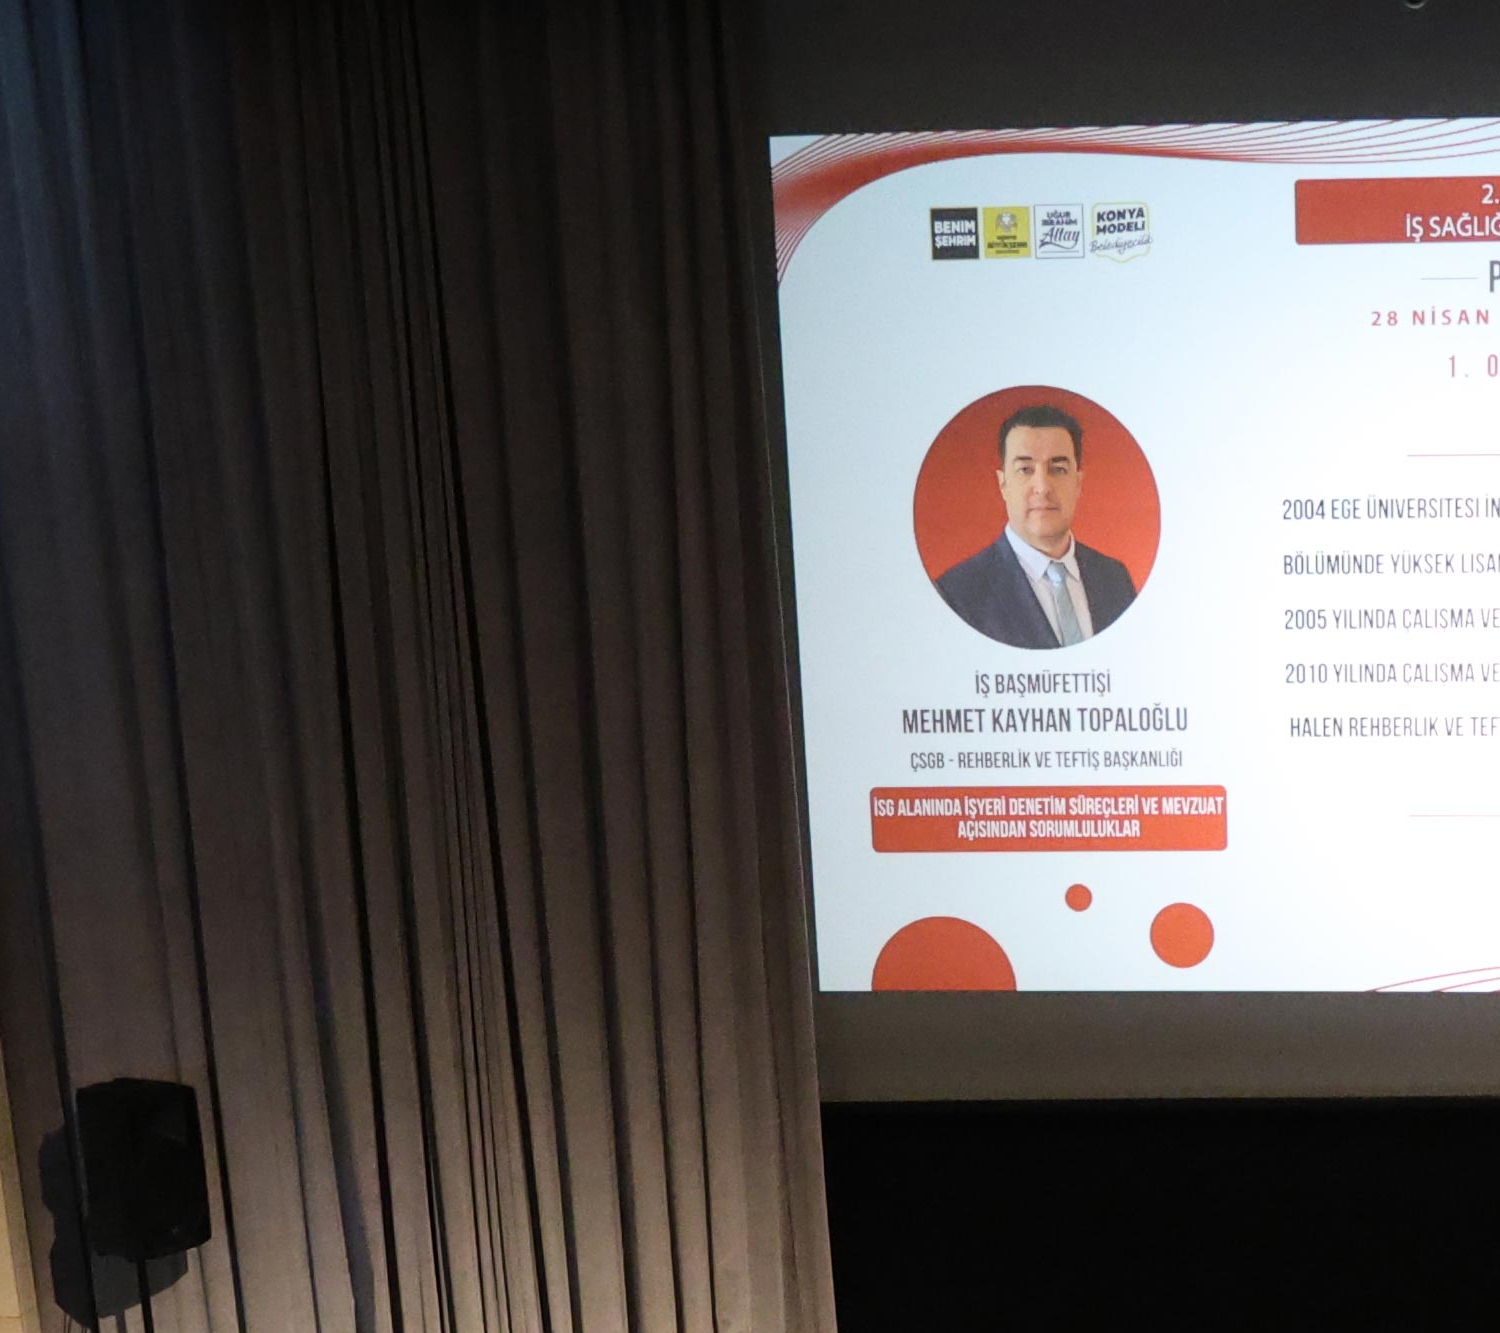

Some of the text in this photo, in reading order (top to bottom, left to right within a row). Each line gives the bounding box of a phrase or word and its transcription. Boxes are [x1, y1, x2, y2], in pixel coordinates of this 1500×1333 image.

[1481, 183, 1500, 205] 2.
[1096, 207, 1144, 222] KONYA
[1406, 214, 1424, 243] İŞ
[1372, 311, 1398, 326] 28
[1412, 306, 1489, 326] NİSAN
[1449, 355, 1468, 378] 1.
[1283, 499, 1325, 520] 2004
[1331, 498, 1361, 520] EGE
[1284, 550, 1383, 575] BÖLÜMÜNDE
[1391, 550, 1454, 574] YÜKSEK
[1285, 609, 1327, 630] 2005
[1333, 609, 1396, 629] YILINDA
[1403, 608, 1474, 632] ÇALIŞMA
[1481, 608, 1500, 628] VE
[975, 669, 1110, 698] İŞ BAŞMÜFETTİŞİ
[1286, 663, 1327, 684] 2010
[1333, 663, 1397, 683] YILINDA
[1403, 663, 1474, 685] ÇALIŞMA
[1481, 663, 1499, 682] VE
[902, 703, 1187, 734] MEHMET KAYHAN TOPALOĞLU
[1291, 717, 1342, 737] HALEN
[1445, 717, 1463, 736] VE
[911, 752, 945, 773] ÇSGB
[958, 749, 1031, 769] REHBERLİK
[1035, 751, 1052, 768] VE
[1055, 748, 1099, 771] TEFTİŞ
[1104, 748, 1182, 771] BAŞKANLIĞI
[874, 795, 1224, 819] İSG ALANINDA İŞYERİ DENETİM SÜREÇLERİ VE MEVZUAT
[958, 819, 1140, 840] AÇISINDAN SORUMLULUKLAR
